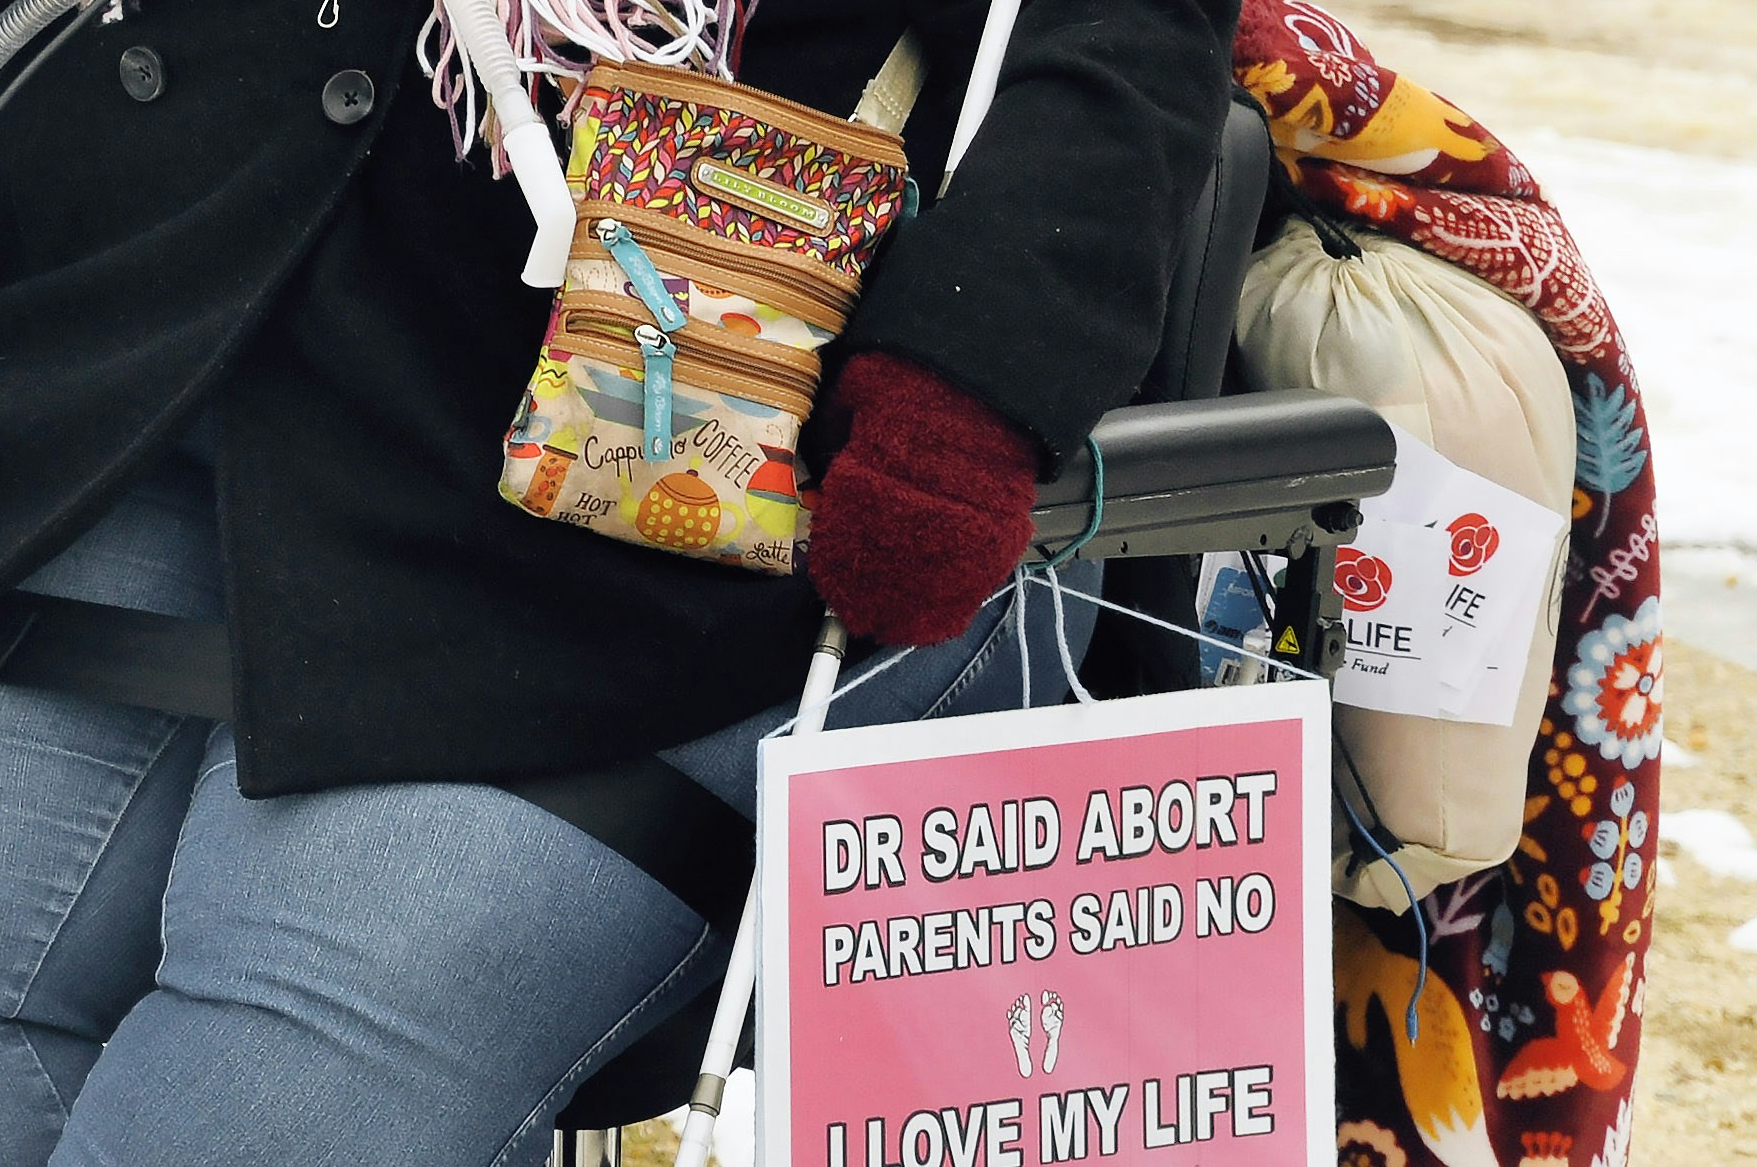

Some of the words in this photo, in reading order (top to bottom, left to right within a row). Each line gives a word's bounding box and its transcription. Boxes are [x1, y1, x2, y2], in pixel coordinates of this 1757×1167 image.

[693, 419, 759, 489] COFFEE
[575, 492, 617, 516] HOT
[746, 541, 791, 566] Latte
[1351, 658, 1389, 675] Fund
[823, 819, 905, 894] DR
[922, 796, 1060, 883] SAID
[1078, 772, 1278, 863] ABORT
[823, 898, 1055, 986] PARENTS
[1069, 883, 1183, 956] SAID
[1196, 872, 1276, 938] NO
[865, 1098, 1024, 1167] LOVE
[1040, 1084, 1130, 1166] MY
[1143, 1065, 1275, 1150] LIFE
